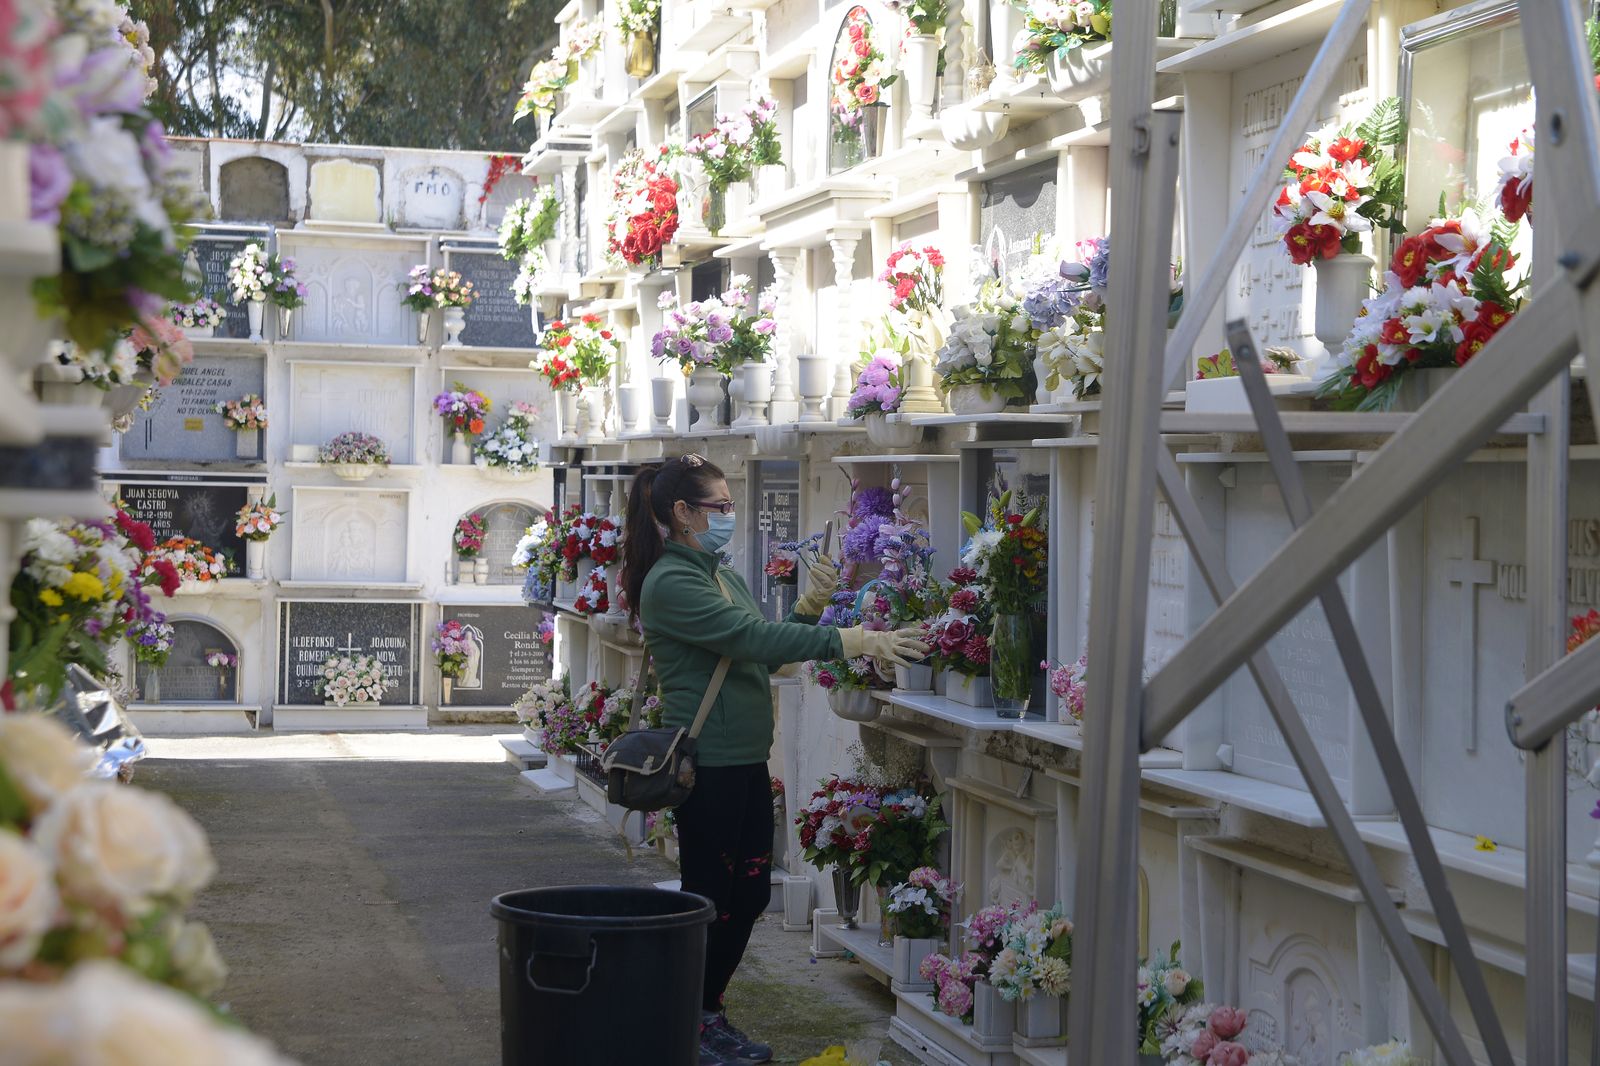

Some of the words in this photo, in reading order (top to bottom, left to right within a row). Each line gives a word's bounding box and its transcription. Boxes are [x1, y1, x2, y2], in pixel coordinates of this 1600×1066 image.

[171, 378, 205, 387] ONZALEZ
[206, 379, 233, 388] CASAS
[126, 488, 146, 499] JUAN
[147, 489, 180, 499] SEGOVIA
[137, 500, 167, 510] CASTRO
[152, 520, 171, 529] AÑOS
[503, 630, 531, 640] Cecilia
[292, 636, 335, 648] ILDEFONSO
[369, 637, 407, 649] JOAQUINA
[514, 640, 540, 649] Ronda
[376, 650, 397, 662] MOYA
[511, 666, 535, 674] Siempre
